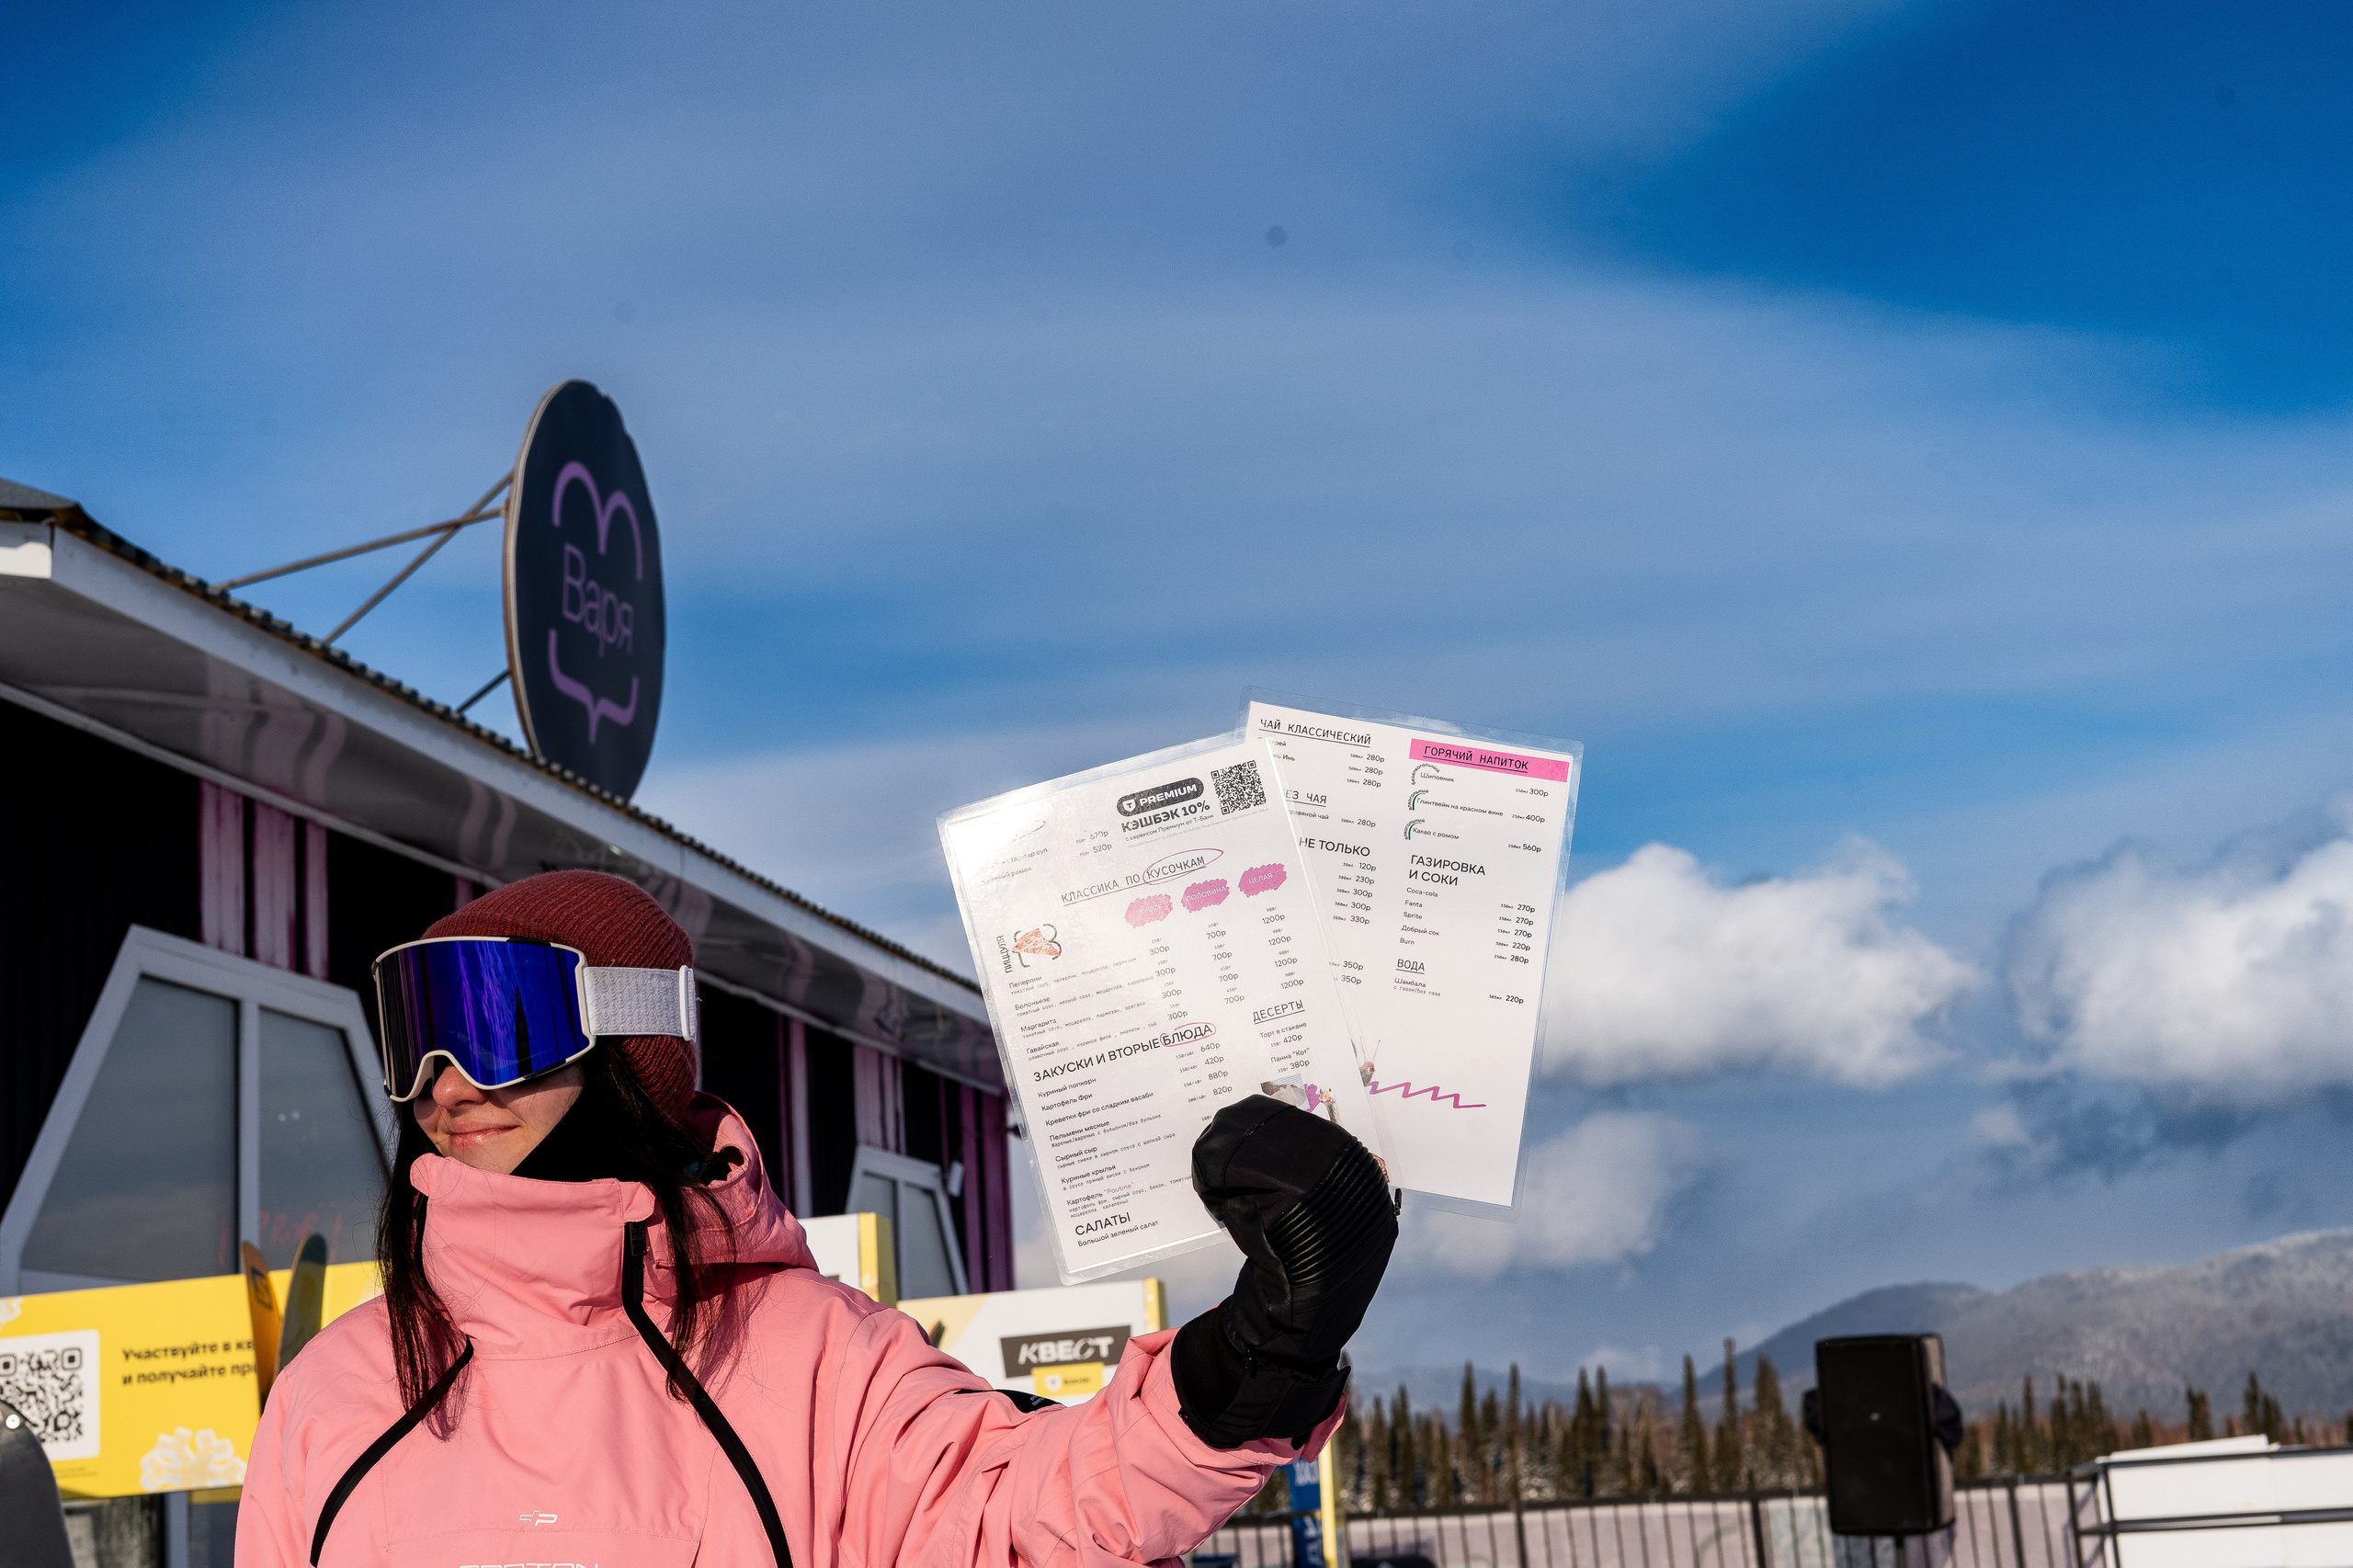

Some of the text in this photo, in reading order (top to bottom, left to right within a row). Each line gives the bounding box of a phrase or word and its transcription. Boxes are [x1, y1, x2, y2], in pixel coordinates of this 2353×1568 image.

[563, 542, 634, 658] Варя
[1260, 719, 1370, 744] ЧАЙ КЛАССИЧЕСКИЙ
[1366, 754, 1385, 763] 280р
[1424, 745, 1529, 769] ГОРЯЧИЙ НАПИТОК
[1364, 766, 1383, 776] 280р
[1420, 772, 1454, 782] Шиповник
[1362, 778, 1381, 788] 280р
[1139, 783, 1197, 806] PREMIUM
[1306, 792, 1326, 804] ЧАЯ
[1529, 788, 1549, 797] 300р
[1416, 797, 1449, 808] Глинтвейн
[1120, 808, 1180, 833] КЭШБЭК
[1181, 800, 1211, 816] 10%
[1525, 814, 1545, 824] 400р
[1130, 829, 1157, 840] сервисом
[1157, 822, 1185, 832] Премиум
[1192, 813, 1214, 823] Т-Банк
[1357, 818, 1376, 828] 280р
[1412, 827, 1431, 835] Какао
[1092, 843, 1112, 853] 520р
[1318, 839, 1370, 857] ТОЛЬКО
[1522, 843, 1541, 853] 560р
[1358, 862, 1376, 872] 120р
[1410, 854, 1485, 875] ГАЗИРОВКА
[1061, 856, 1206, 903] КЛАССИКА ПО КУСОЧКАМ
[1248, 872, 1273, 884] ЦЕЛАЯ
[1355, 875, 1374, 885] 230р
[1408, 869, 1458, 886] И СОКИ
[1185, 886, 1227, 903] ПОЛОВИНА
[1352, 888, 1373, 898] 300р
[1405, 887, 1438, 897] Coca-cola
[1350, 901, 1371, 912] 300р
[1404, 899, 1423, 907] Fanta
[1517, 903, 1535, 914] 270р
[1138, 903, 1163, 915] КУСОК
[1262, 914, 1285, 924] 1200р
[1350, 915, 1370, 925] 330р
[1403, 911, 1423, 919] Sprite
[1515, 916, 1534, 926] 270р
[1206, 929, 1226, 939] 700р
[1401, 925, 1427, 934] Добрый
[1514, 928, 1532, 938] 270р
[1267, 936, 1291, 946] 1200р
[1399, 937, 1415, 945] Burn
[1512, 941, 1530, 951] 220р
[995, 935, 1013, 973] ПИЦЦУЛЯ
[1149, 945, 1170, 955] 300р
[1211, 951, 1233, 961] 700р
[1509, 954, 1529, 964] 280р
[1274, 957, 1298, 968] 1200р
[1342, 960, 1364, 971] 350р
[1396, 958, 1425, 971] ВОДА
[1154, 967, 1176, 977] 300р
[1218, 972, 1238, 983] 700р
[1008, 976, 1041, 989] Пеперони
[1280, 979, 1304, 989] 1200р
[1340, 974, 1361, 985] 350р
[1394, 977, 1426, 987] Шамбала
[1161, 988, 1182, 999] 300р
[1014, 996, 1050, 1011] Болоньезе
[1223, 994, 1245, 1005] 700р
[1506, 994, 1524, 1005] 220р
[1167, 1010, 1188, 1020] 300р
[1253, 999, 1303, 1022] ДЕСЕРТЫ
[1020, 1018, 1057, 1032] Маргарита
[1259, 1030, 1275, 1039] Торт
[1280, 1022, 1307, 1033] стакане
[1282, 1034, 1302, 1043] 420р
[1026, 1040, 1059, 1054] Гавайская
[1200, 1042, 1221, 1052] 640р
[1033, 1024, 1212, 1082] ЗАКУСКИ И ВТОРЫЕ БЛЮДА
[1270, 1047, 1310, 1062] Панна "Кот"
[1204, 1055, 1224, 1064] 420р
[1290, 1060, 1310, 1069] 380р
[1208, 1070, 1228, 1080] 880р
[1037, 1078, 1097, 1097] Куриный попкорн
[1212, 1085, 1233, 1096] 820р
[1040, 1098, 1077, 1111] Картофель
[1045, 1113, 1076, 1126] Креветки
[1077, 1109, 1091, 1118] фри
[1100, 1098, 1130, 1110] сладким
[1130, 1091, 1154, 1102] васаби
[1049, 1120, 1109, 1142] Пельмени мясные
[1054, 1146, 1097, 1162] Сырный сыр
[1061, 1165, 1116, 1184] Куриные крылья
[1066, 1193, 1103, 1206] Картофель
[1074, 1211, 1131, 1235] САЛАТЫ
[1077, 1220, 1158, 1247] Большой зеленый салат
[122, 1342, 218, 1360] Участвуйте
[1017, 1335, 1115, 1366] КВЕСТ
[137, 1363, 226, 1384] получайте
